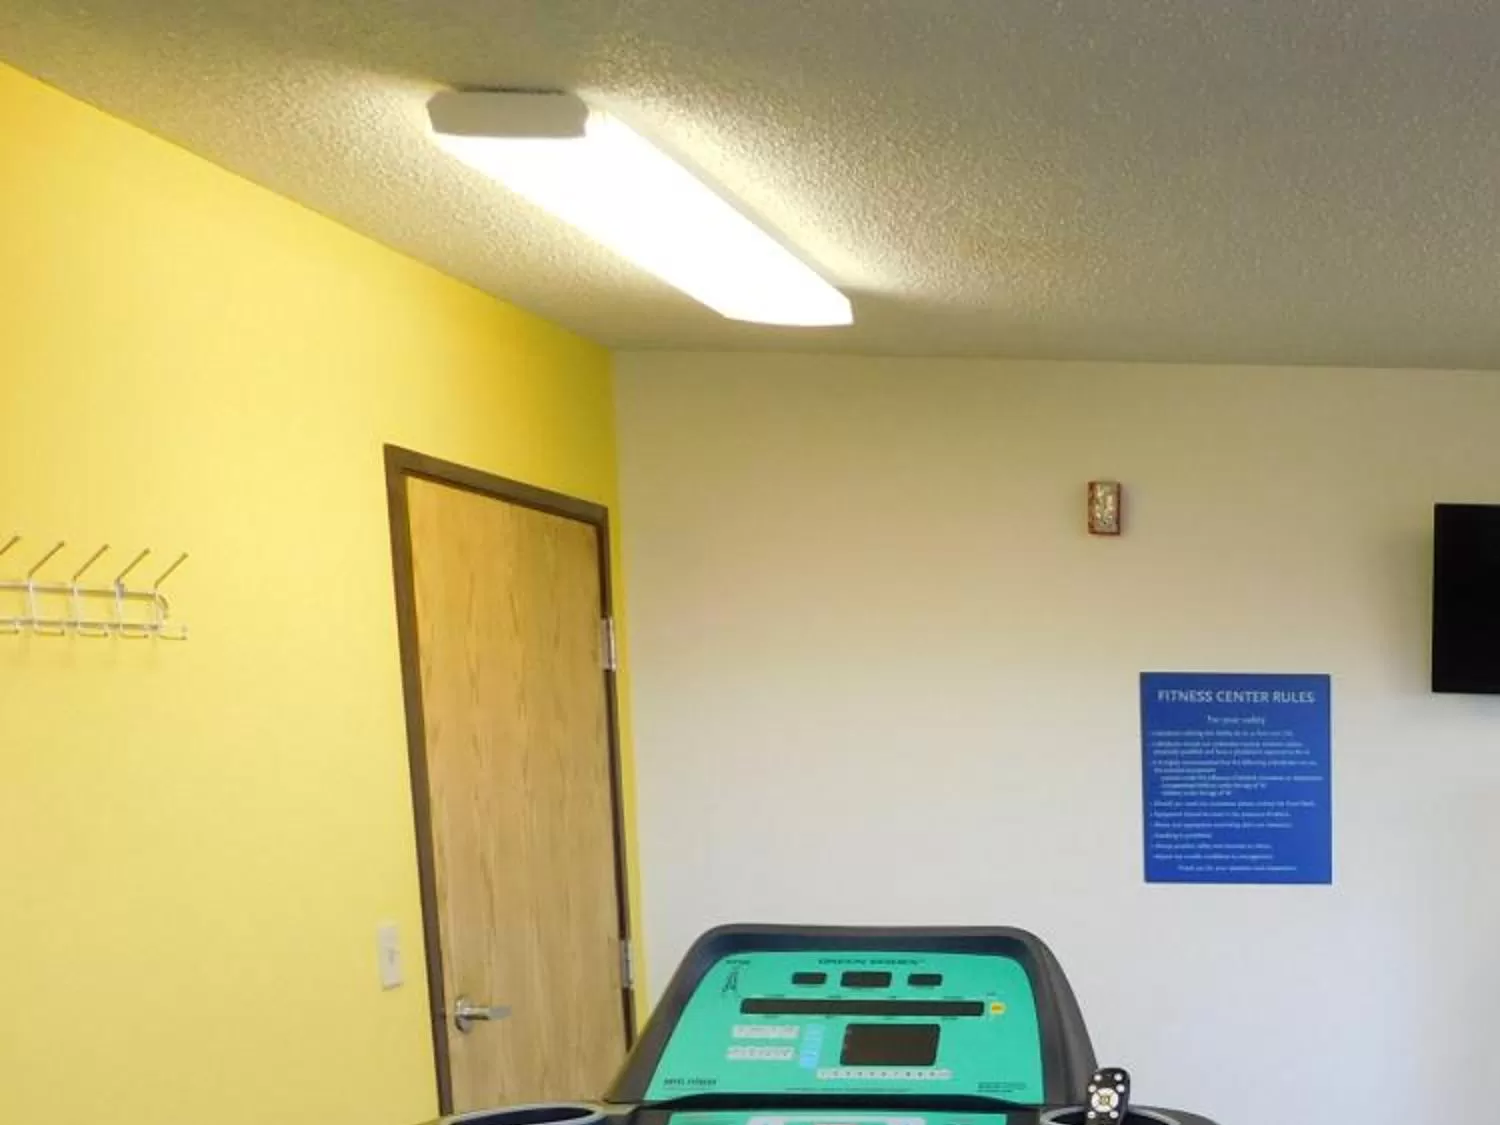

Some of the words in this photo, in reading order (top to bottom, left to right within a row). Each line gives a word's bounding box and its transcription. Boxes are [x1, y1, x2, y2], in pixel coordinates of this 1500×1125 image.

[1157, 689, 1213, 703] FITNESS
[1215, 690, 1269, 703] CENTER
[1272, 691, 1315, 704] RULES
